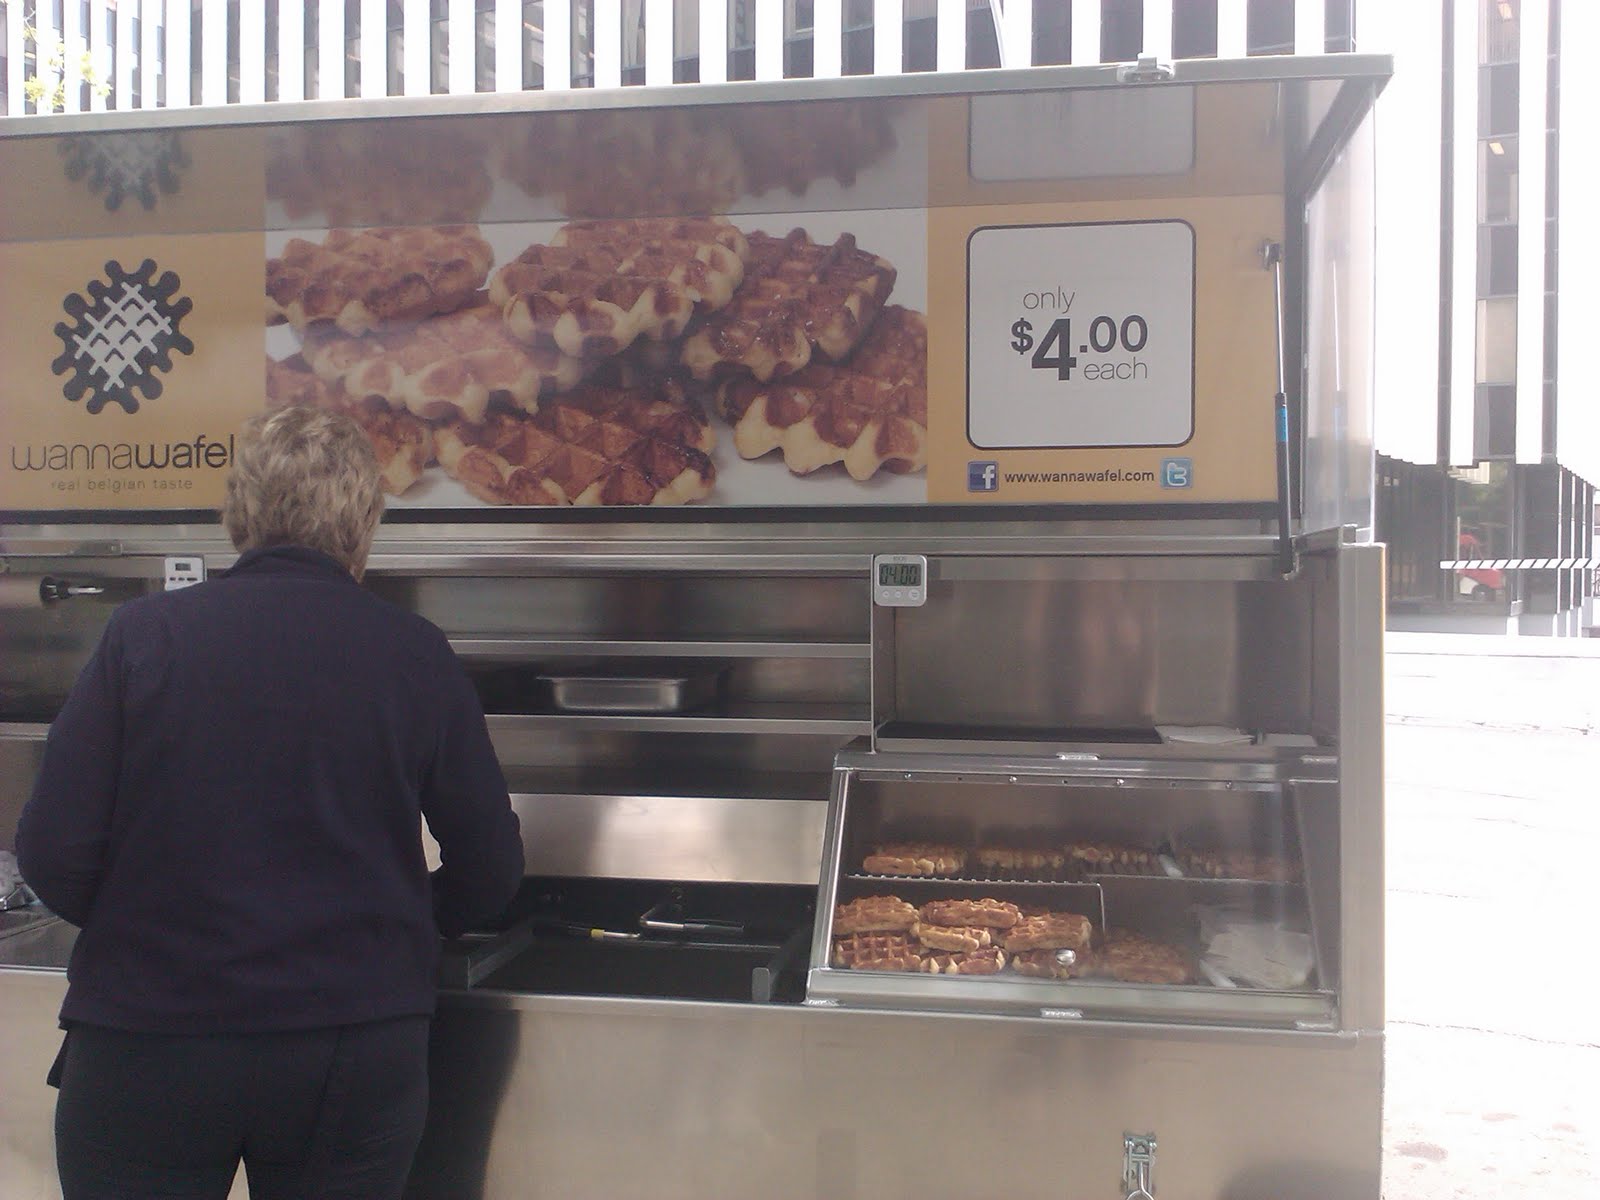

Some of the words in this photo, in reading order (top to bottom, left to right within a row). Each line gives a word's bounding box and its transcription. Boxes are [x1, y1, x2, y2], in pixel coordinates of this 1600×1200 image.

[1022, 286, 1076, 314] only
[1011, 315, 1148, 381] $4.00
[1083, 357, 1148, 381] each
[12, 433, 235, 471] wannawafel
[51, 479, 81, 491] real
[87, 478, 146, 493] belgian
[153, 479, 193, 490] taste
[1005, 469, 1155, 484] www.wannawafel.com
